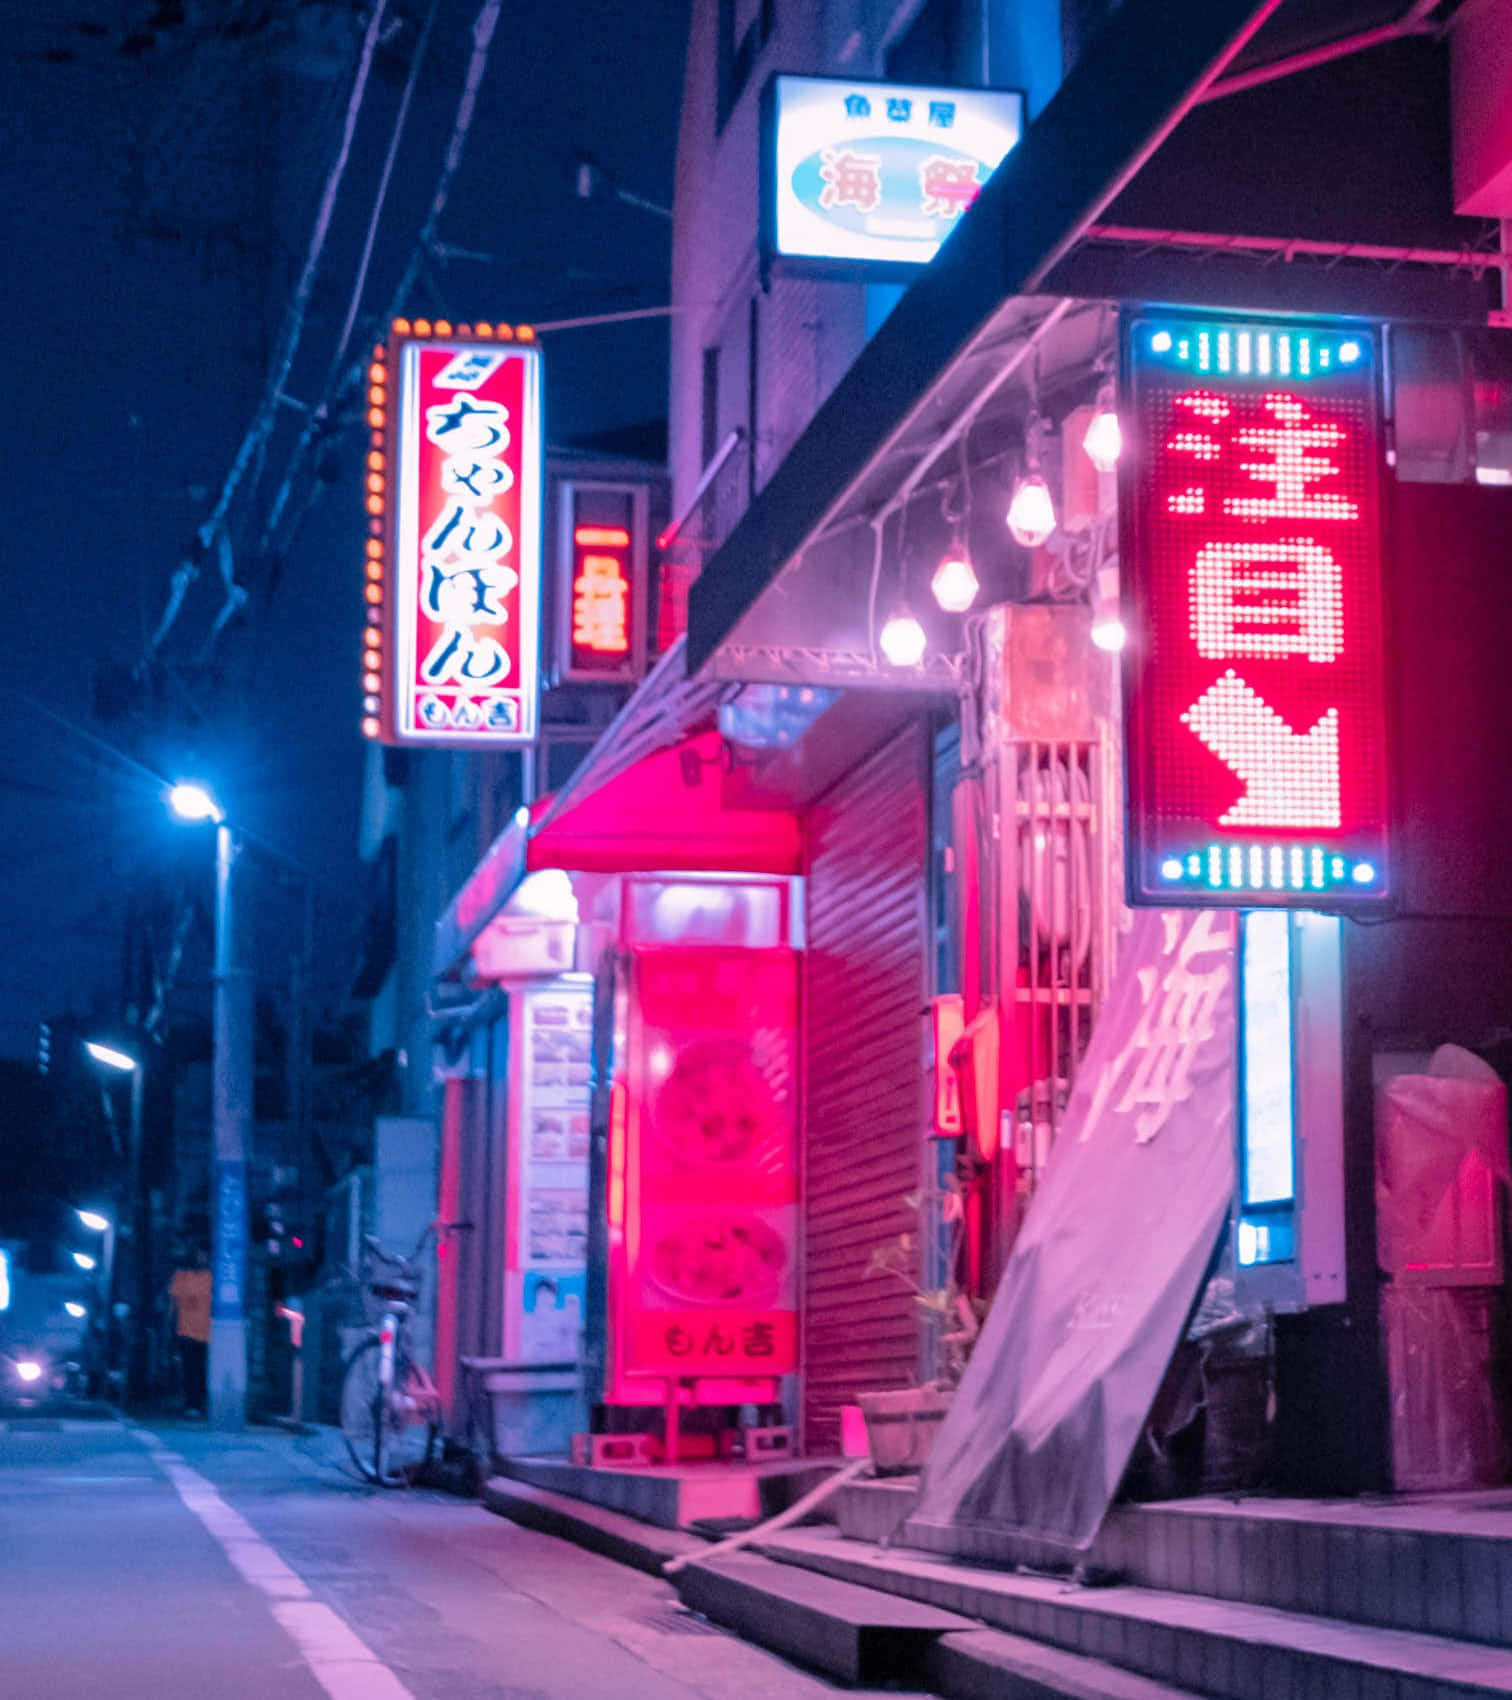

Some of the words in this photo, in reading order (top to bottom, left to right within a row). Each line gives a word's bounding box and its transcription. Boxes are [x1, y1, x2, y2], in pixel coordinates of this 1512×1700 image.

[1168, 390, 1359, 662] 注目
[420, 698, 516, 729] もん吉
[665, 1322, 775, 1358] もん吉
